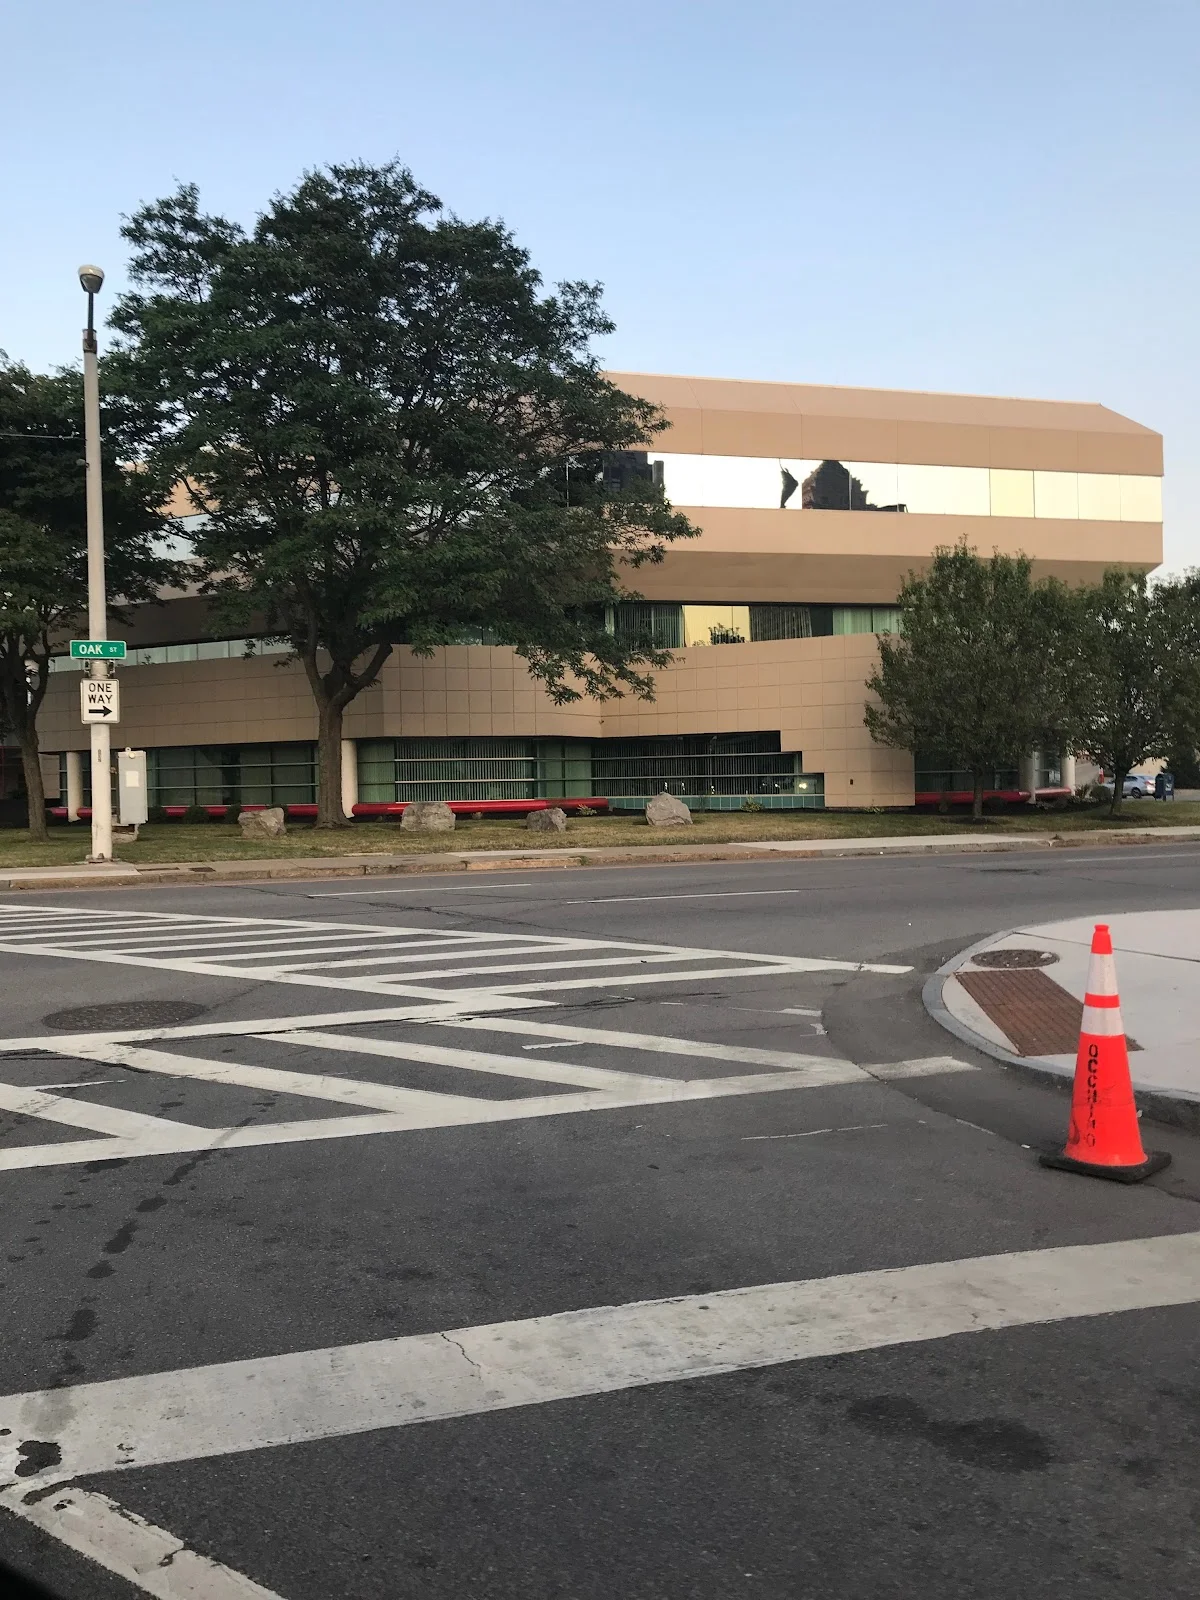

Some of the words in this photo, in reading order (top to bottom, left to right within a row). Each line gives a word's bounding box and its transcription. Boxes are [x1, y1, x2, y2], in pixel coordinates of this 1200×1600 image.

[79, 644, 103, 655] OAK
[88, 682, 112, 693] ONE
[88, 694, 113, 704] WAY
